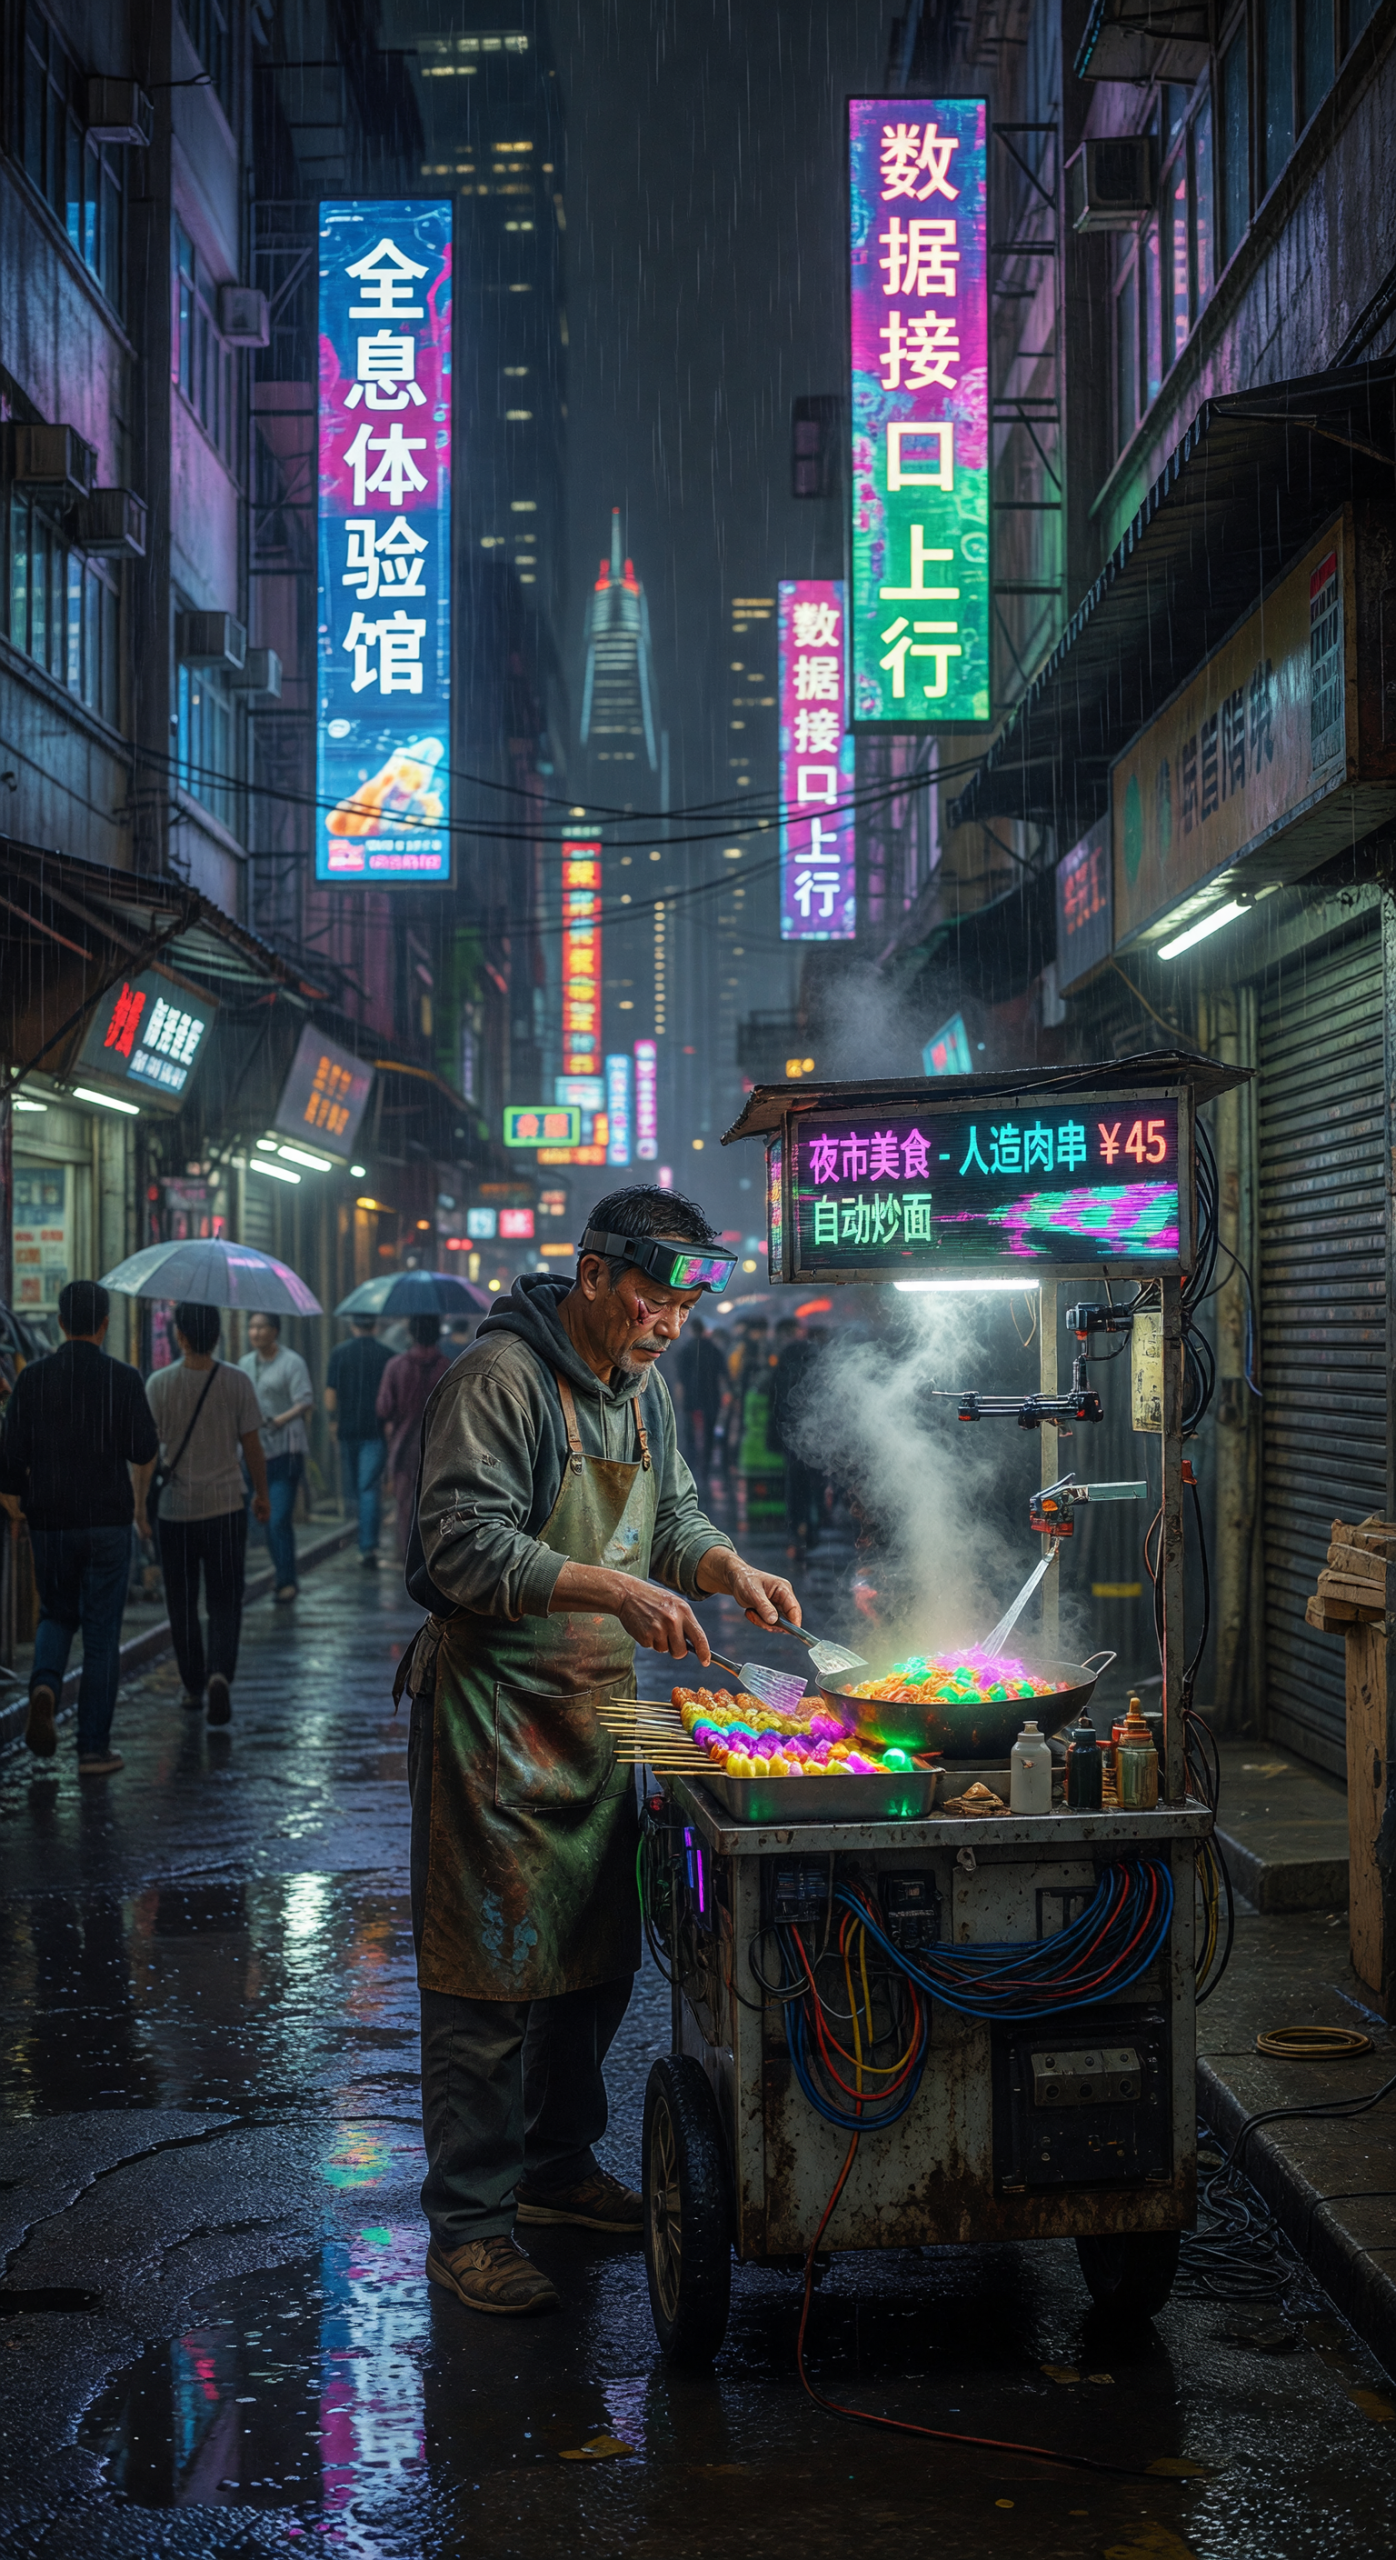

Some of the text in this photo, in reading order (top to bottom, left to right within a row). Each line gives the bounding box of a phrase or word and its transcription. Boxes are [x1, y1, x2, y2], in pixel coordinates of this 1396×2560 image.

[344, 239, 429, 695] 全息体验馆
[880, 124, 961, 698] 数据接口上行
[793, 602, 840, 917] 数据接口上行
[809, 1128, 931, 1184] 夜市美食
[959, 1120, 1087, 1176] 人造肉串
[1098, 1120, 1167, 1164] ¥45
[814, 1193, 932, 1245] 自动炒面
